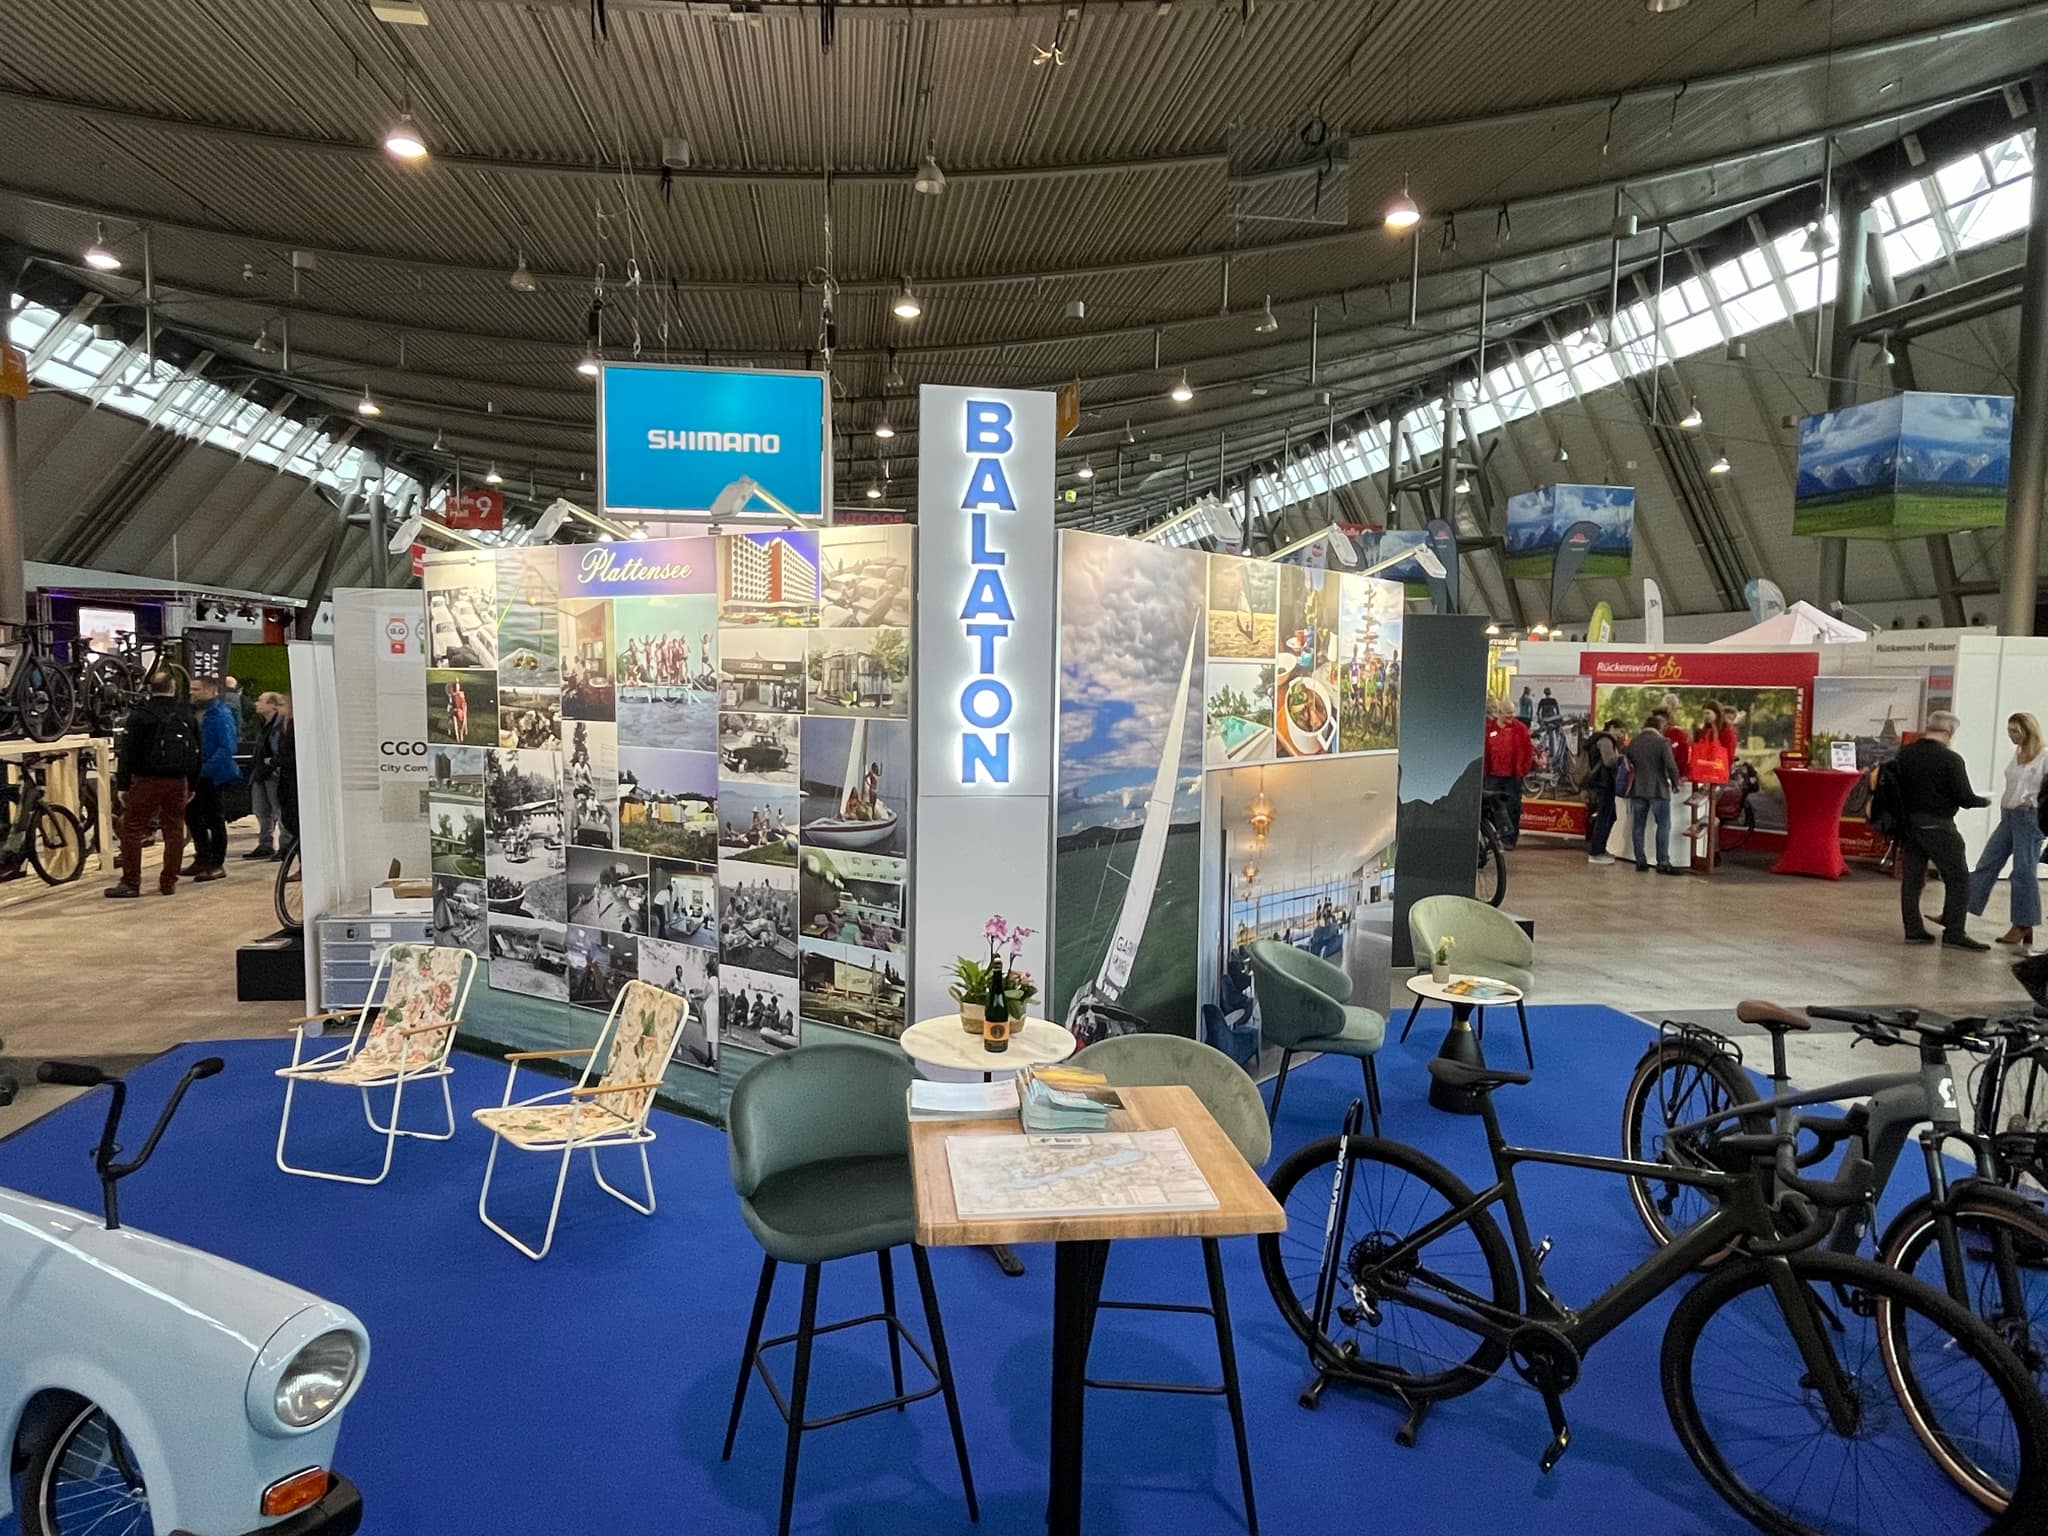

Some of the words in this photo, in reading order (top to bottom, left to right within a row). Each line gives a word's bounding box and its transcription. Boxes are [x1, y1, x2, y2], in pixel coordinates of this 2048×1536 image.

[647, 429, 781, 454] SHIMANO
[475, 496, 493, 518] 9
[577, 547, 693, 584] Plattensee
[960, 399, 1017, 783] BALATON
[211, 644, 220, 679] STYLE
[1597, 662, 1659, 672] Rückenwind
[380, 764, 401, 773] City
